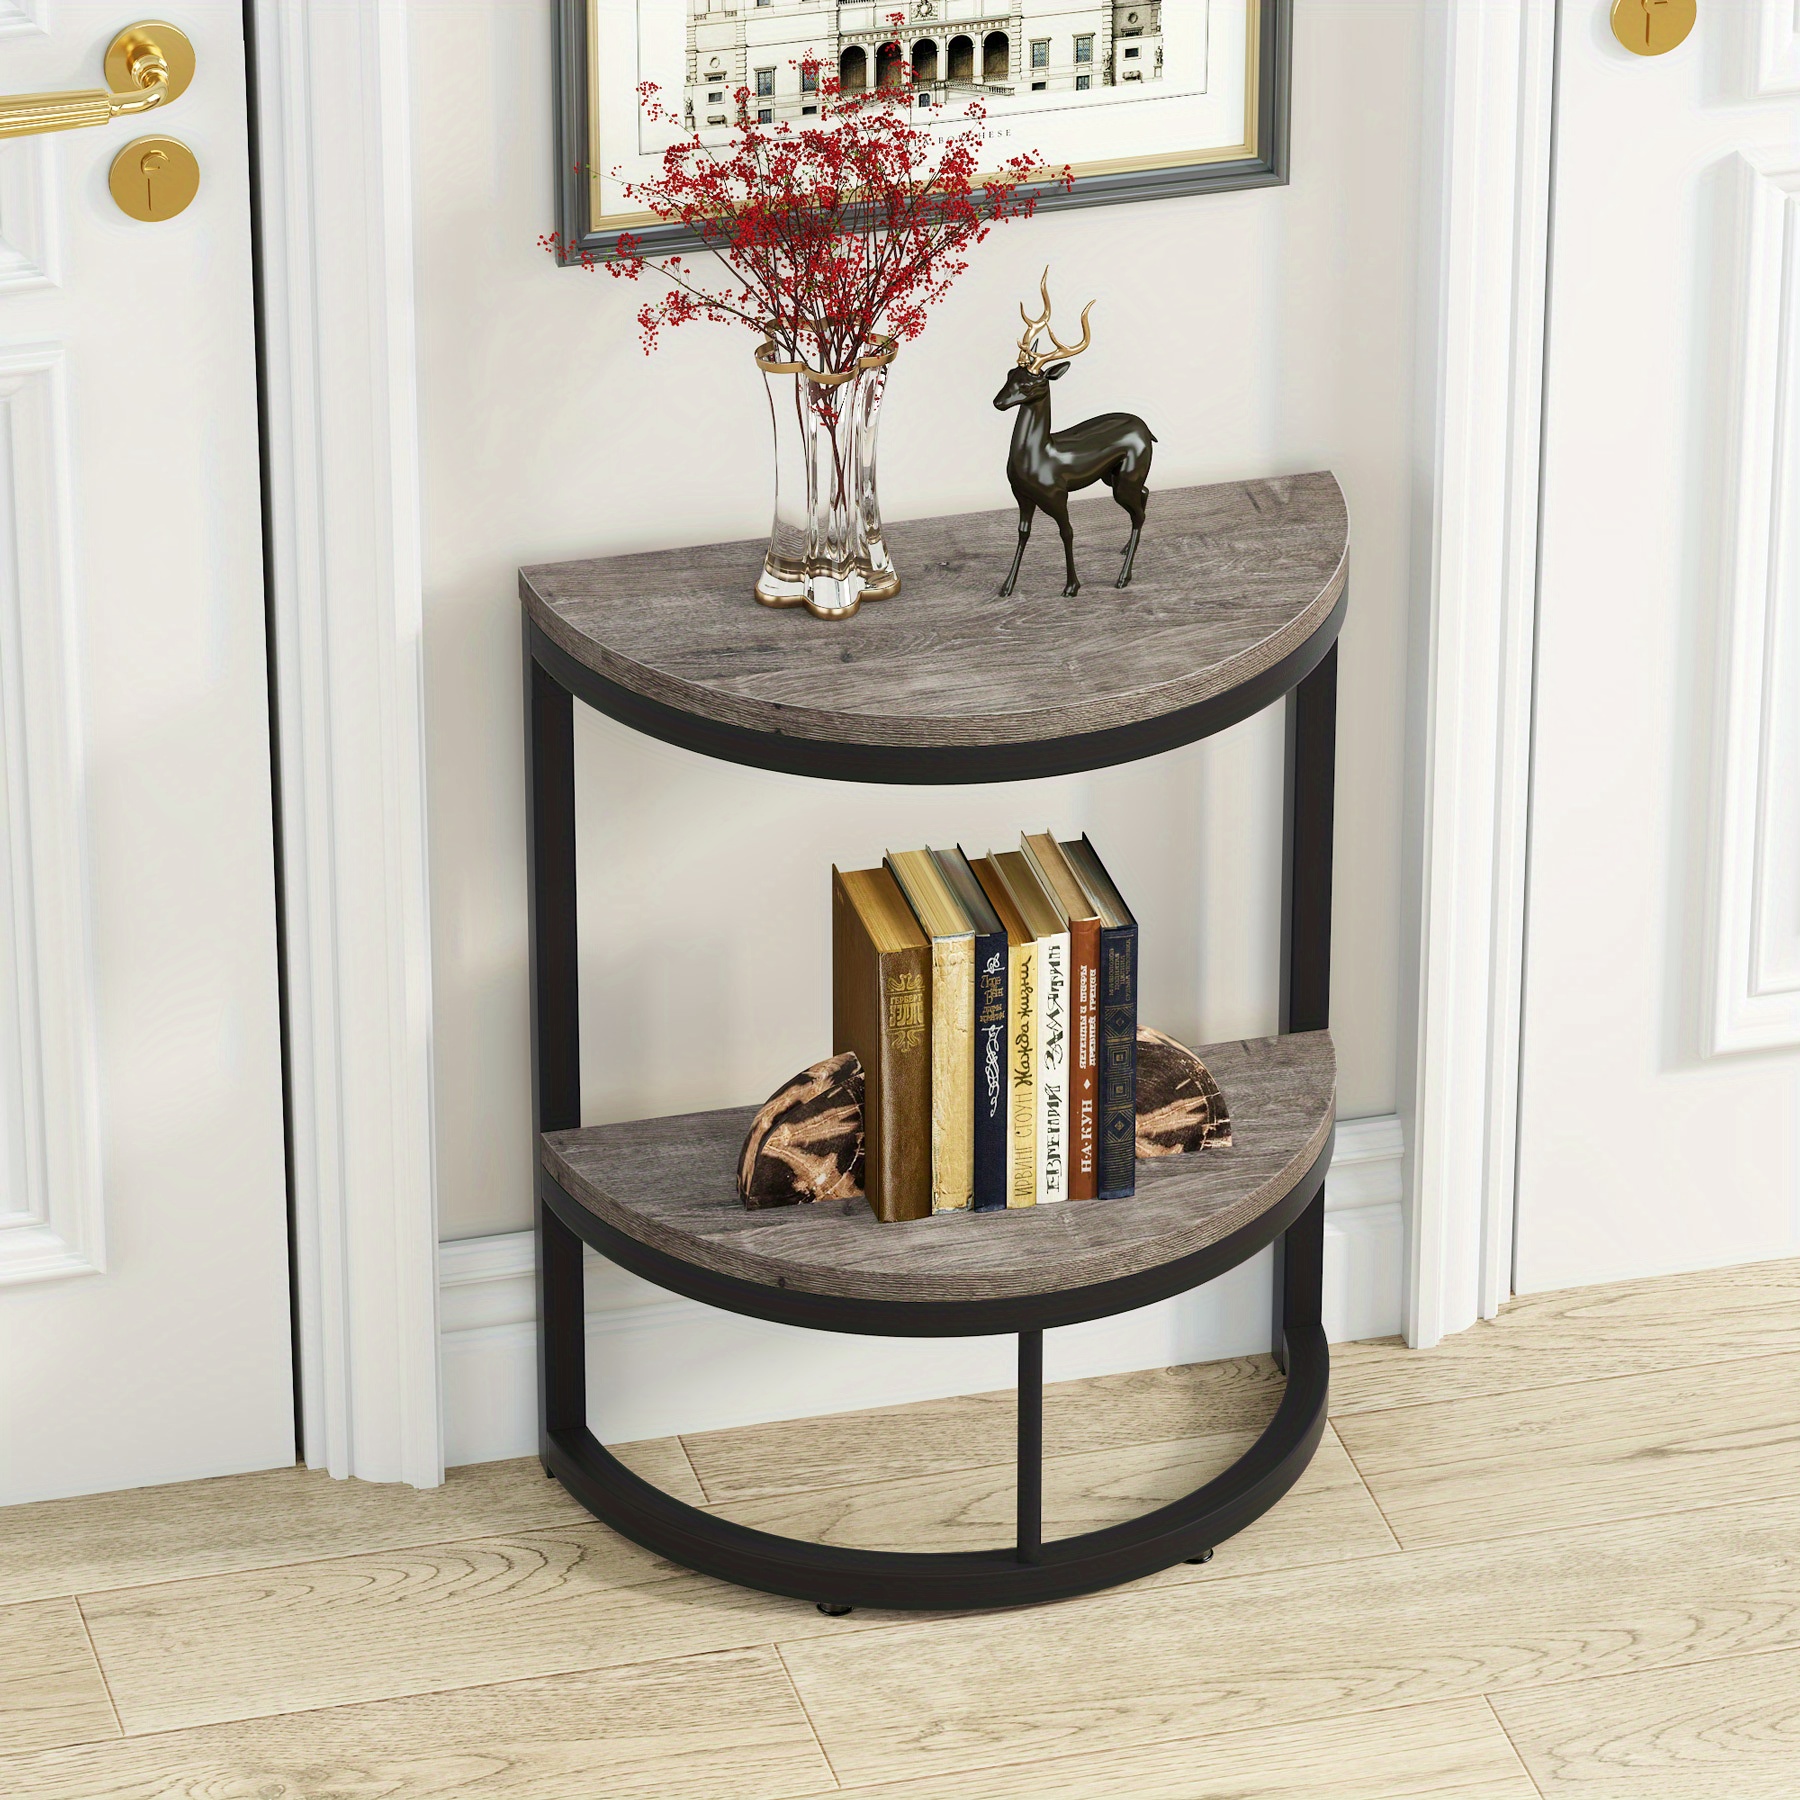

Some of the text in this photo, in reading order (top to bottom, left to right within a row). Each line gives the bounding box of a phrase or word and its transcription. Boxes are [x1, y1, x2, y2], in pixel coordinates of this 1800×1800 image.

[890, 993, 923, 1005] ГЕРБЕРТ
[1013, 954, 1034, 1088] Жажда жизни
[1079, 1015, 1087, 1069] ЛЕГЕНДЫ
[1044, 945, 1064, 1194] ЕВГЕНИЙ ЗАМЯТИН
[1014, 1093, 1033, 1197] ИРВИНГ СТОУН
